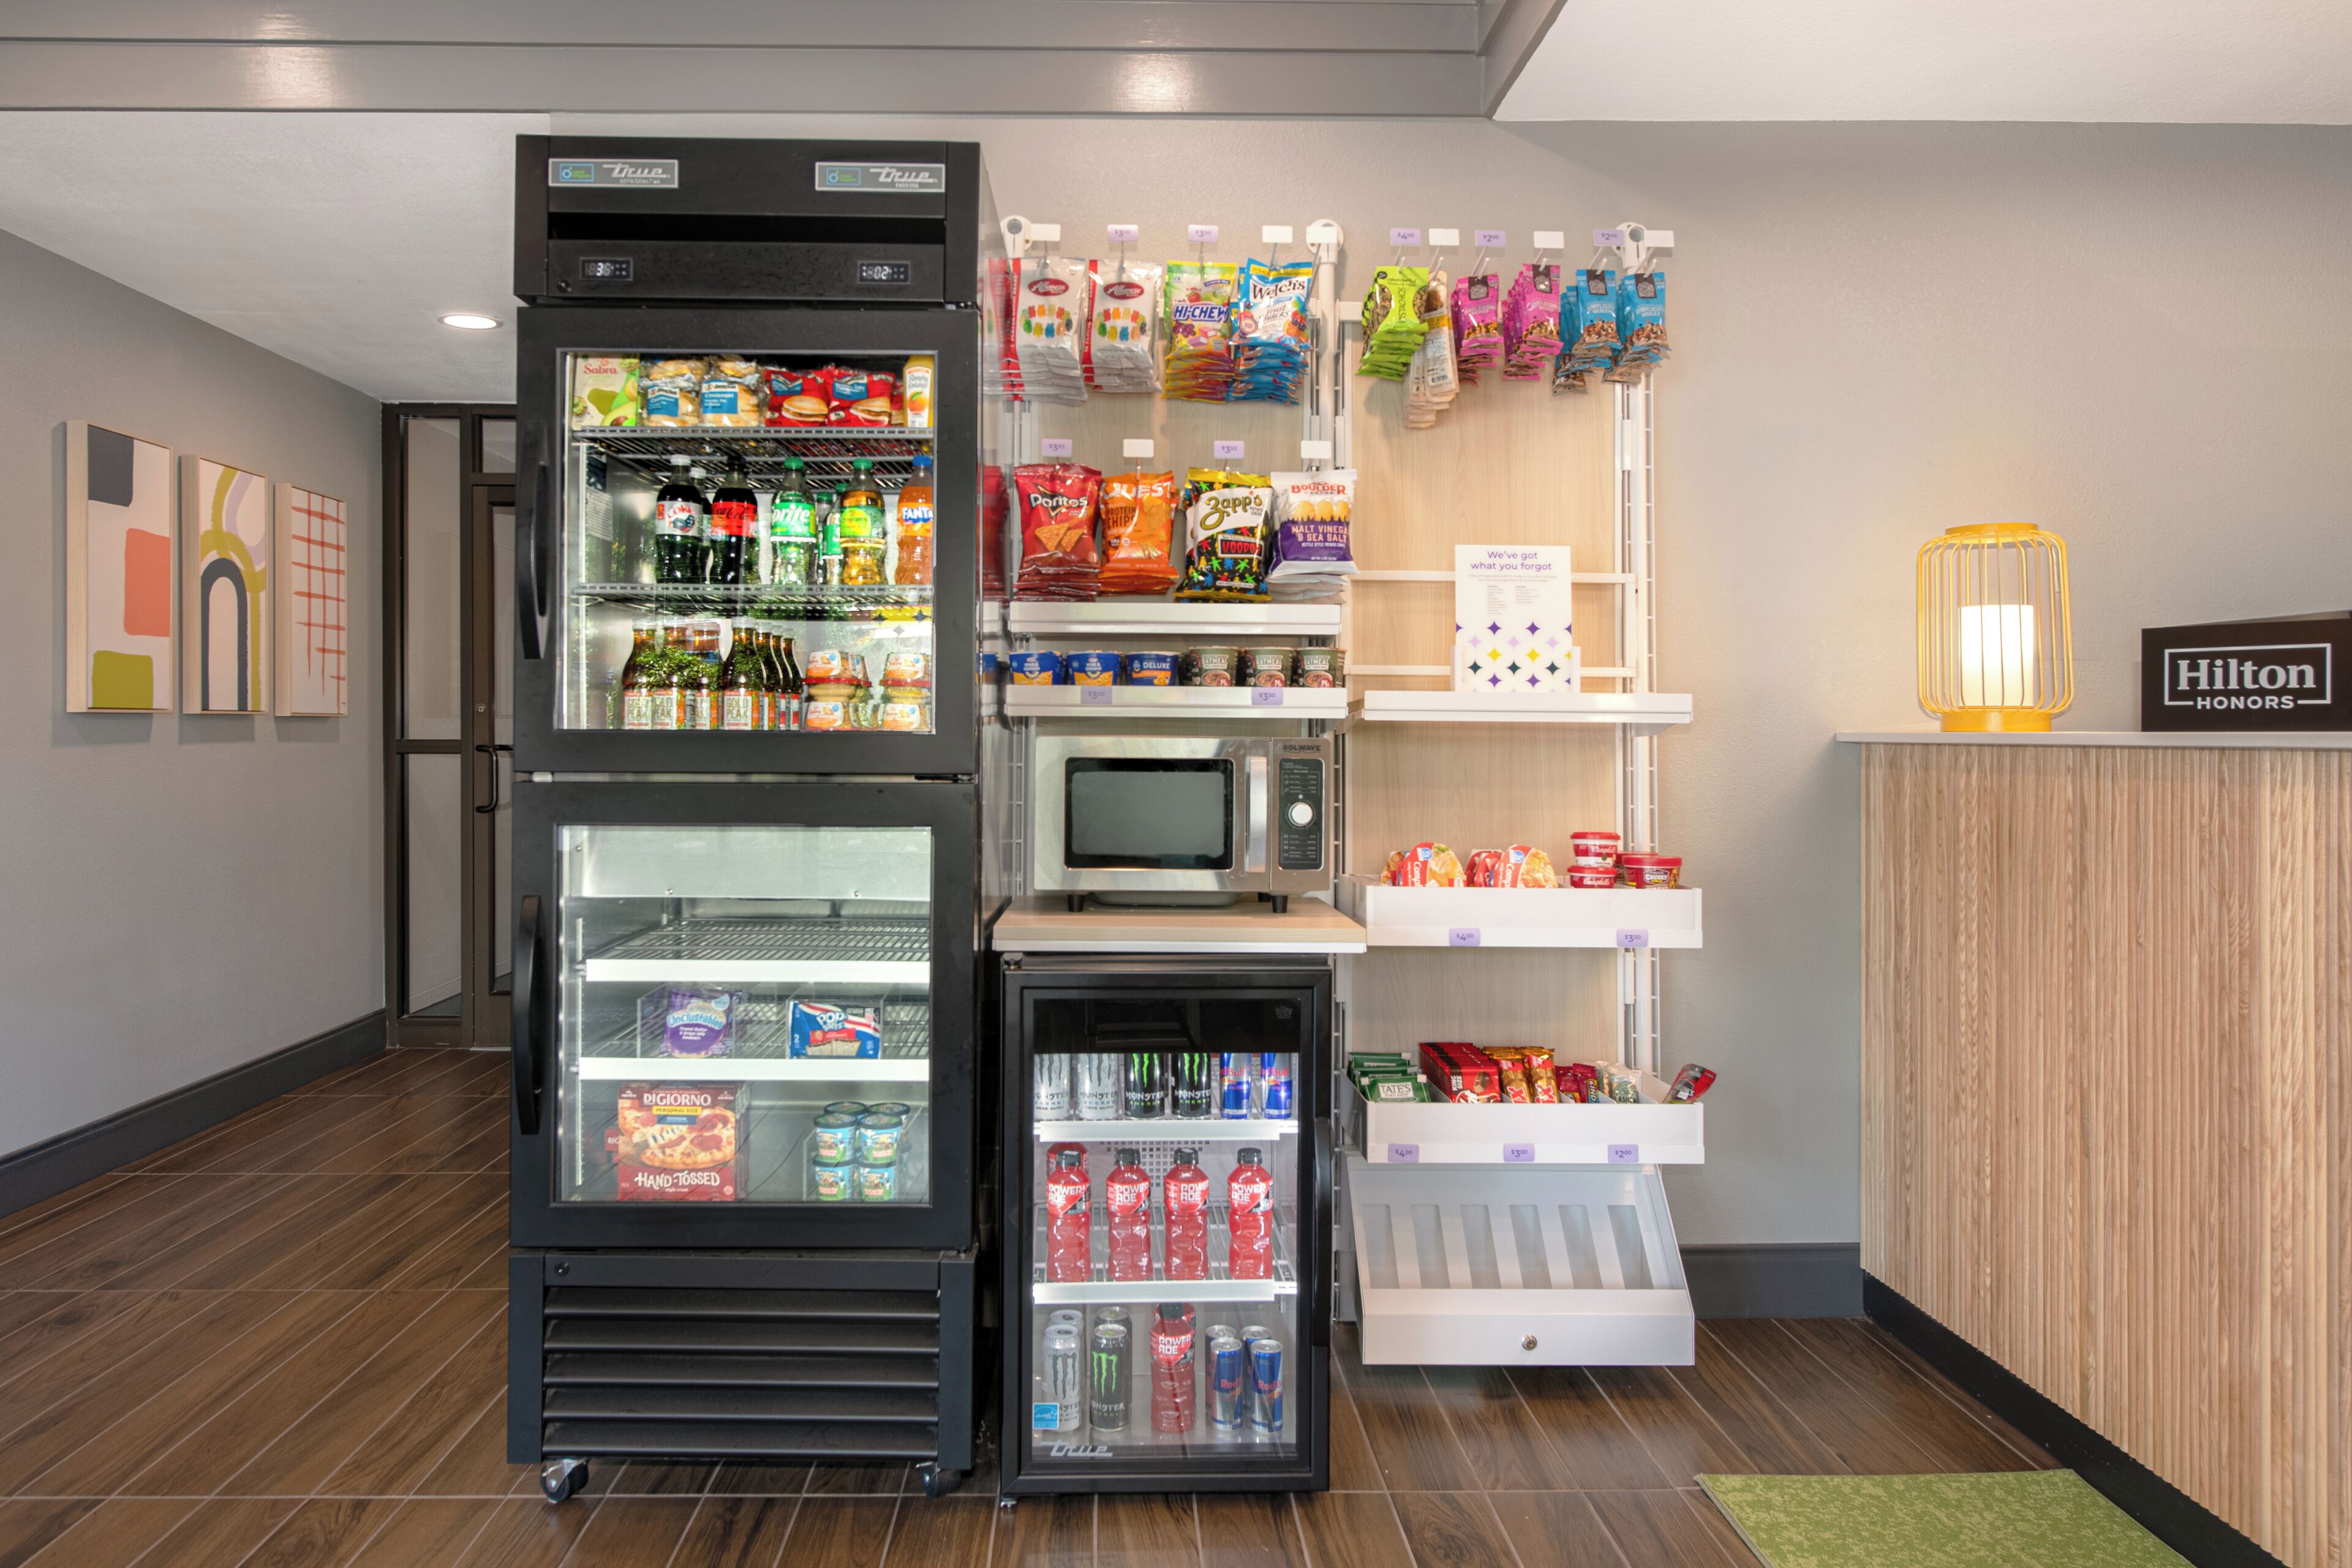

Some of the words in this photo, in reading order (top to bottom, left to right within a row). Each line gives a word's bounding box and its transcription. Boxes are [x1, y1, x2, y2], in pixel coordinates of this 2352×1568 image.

[1253, 280, 1305, 300] Welch's
[1174, 306, 1229, 321] HI-CHEW
[584, 363, 617, 375] Sabra
[1101, 481, 1172, 499] QUEST
[1291, 484, 1346, 494] BOULDER
[1030, 493, 1087, 508] Doritos
[772, 506, 810, 526] prite
[1107, 506, 1136, 516] PROTEIN
[1292, 525, 1314, 533] MALT
[1318, 525, 1348, 535] VINEGA
[1327, 533, 1347, 543] SALT
[1487, 551, 1518, 559] We've
[1521, 552, 1538, 560] got
[1521, 562, 1553, 571] forgot
[2177, 658, 2316, 690] Hilton
[2197, 696, 2294, 709] HONORS
[794, 1034, 799, 1042] 2
[1227, 1067, 1245, 1076] Bull
[1272, 1067, 1289, 1076] Bull
[1174, 1089, 1211, 1099] MONSTE
[1380, 1084, 1411, 1094] TATE'S
[1126, 1090, 1164, 1100] MONSTER
[1049, 1183, 1082, 1195] POWER
[1231, 1182, 1266, 1194] POWER
[1180, 1191, 1201, 1201] ADE
[1158, 1334, 1191, 1345] POWER
[1158, 1344, 1178, 1355] ADE
[1221, 1377, 1237, 1389] Red
[1258, 1379, 1276, 1390] Red
